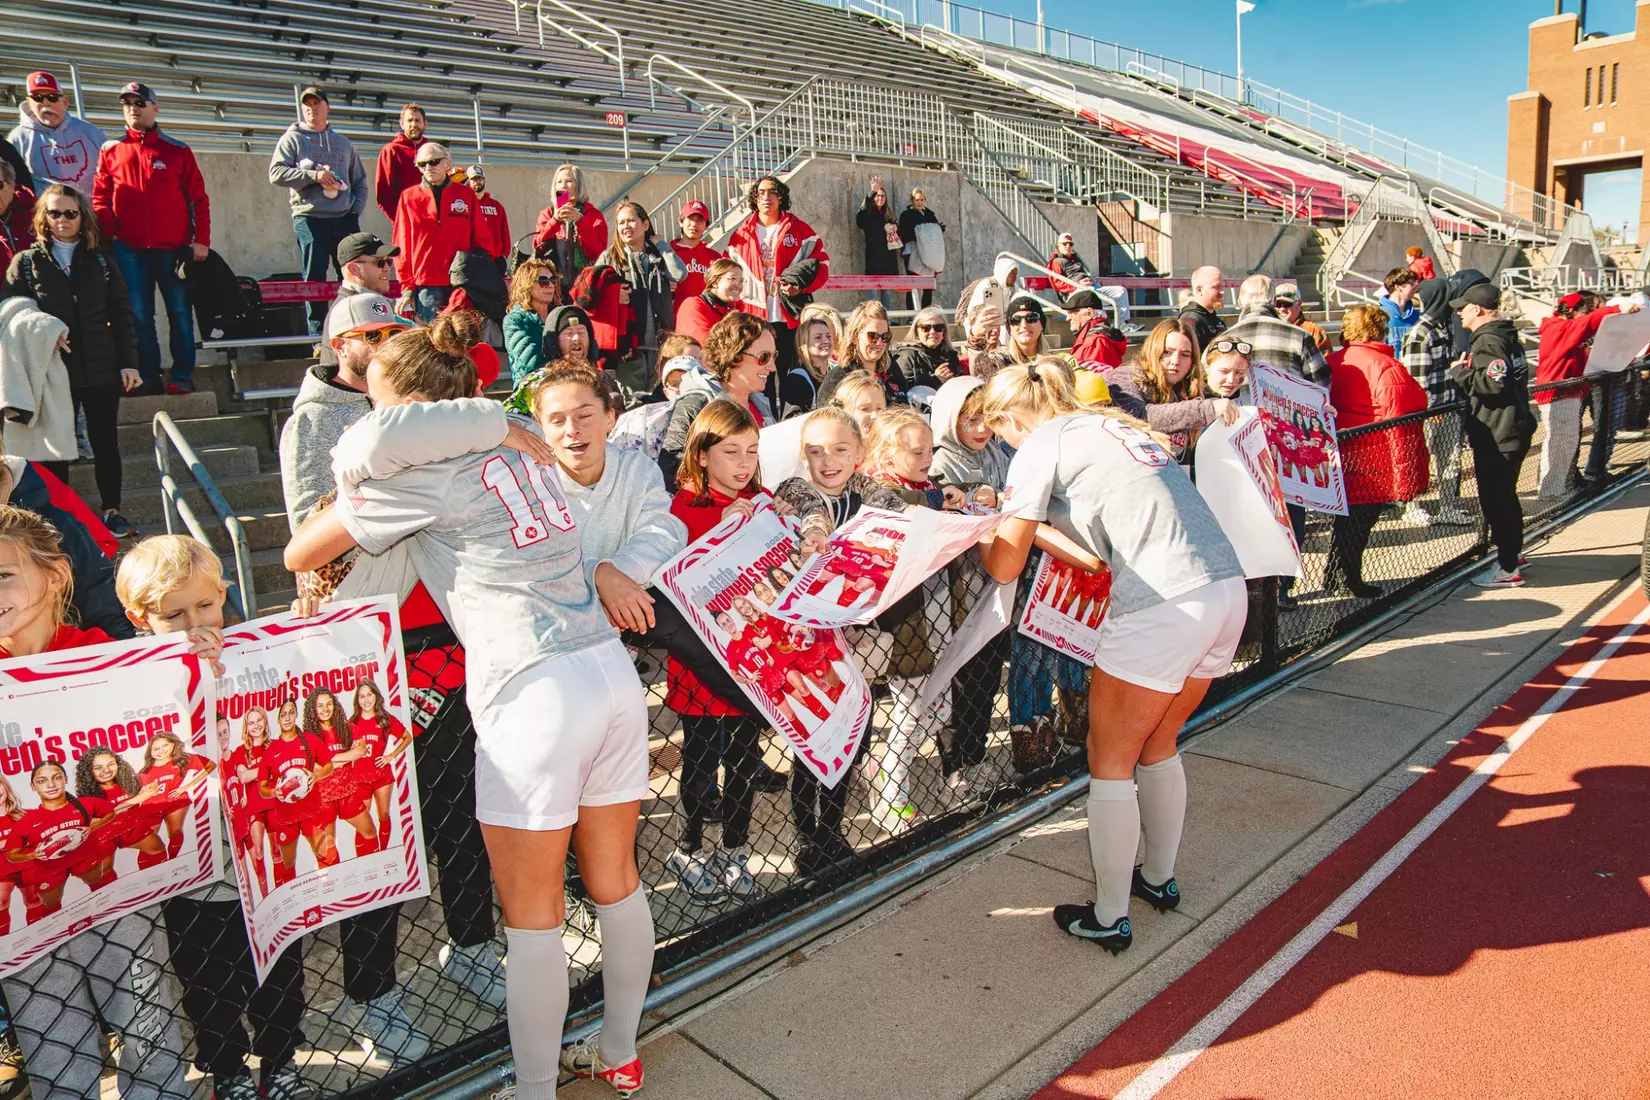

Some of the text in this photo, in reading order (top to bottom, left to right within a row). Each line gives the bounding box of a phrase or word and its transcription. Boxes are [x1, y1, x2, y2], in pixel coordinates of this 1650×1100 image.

[608, 113, 624, 126] 209
[53, 155, 78, 165] THE
[1293, 401, 1320, 419] soccer
[481, 450, 577, 549] 10
[764, 531, 785, 549] 2023
[704, 566, 763, 612] women's
[752, 535, 795, 578] soccer
[690, 567, 738, 610] ohio state
[339, 651, 377, 667] 2023
[236, 663, 281, 697] state
[302, 661, 379, 699] soccer
[123, 702, 177, 721] 2023
[69, 712, 180, 762] soccer
[41, 819, 81, 839] OHIO STATE
